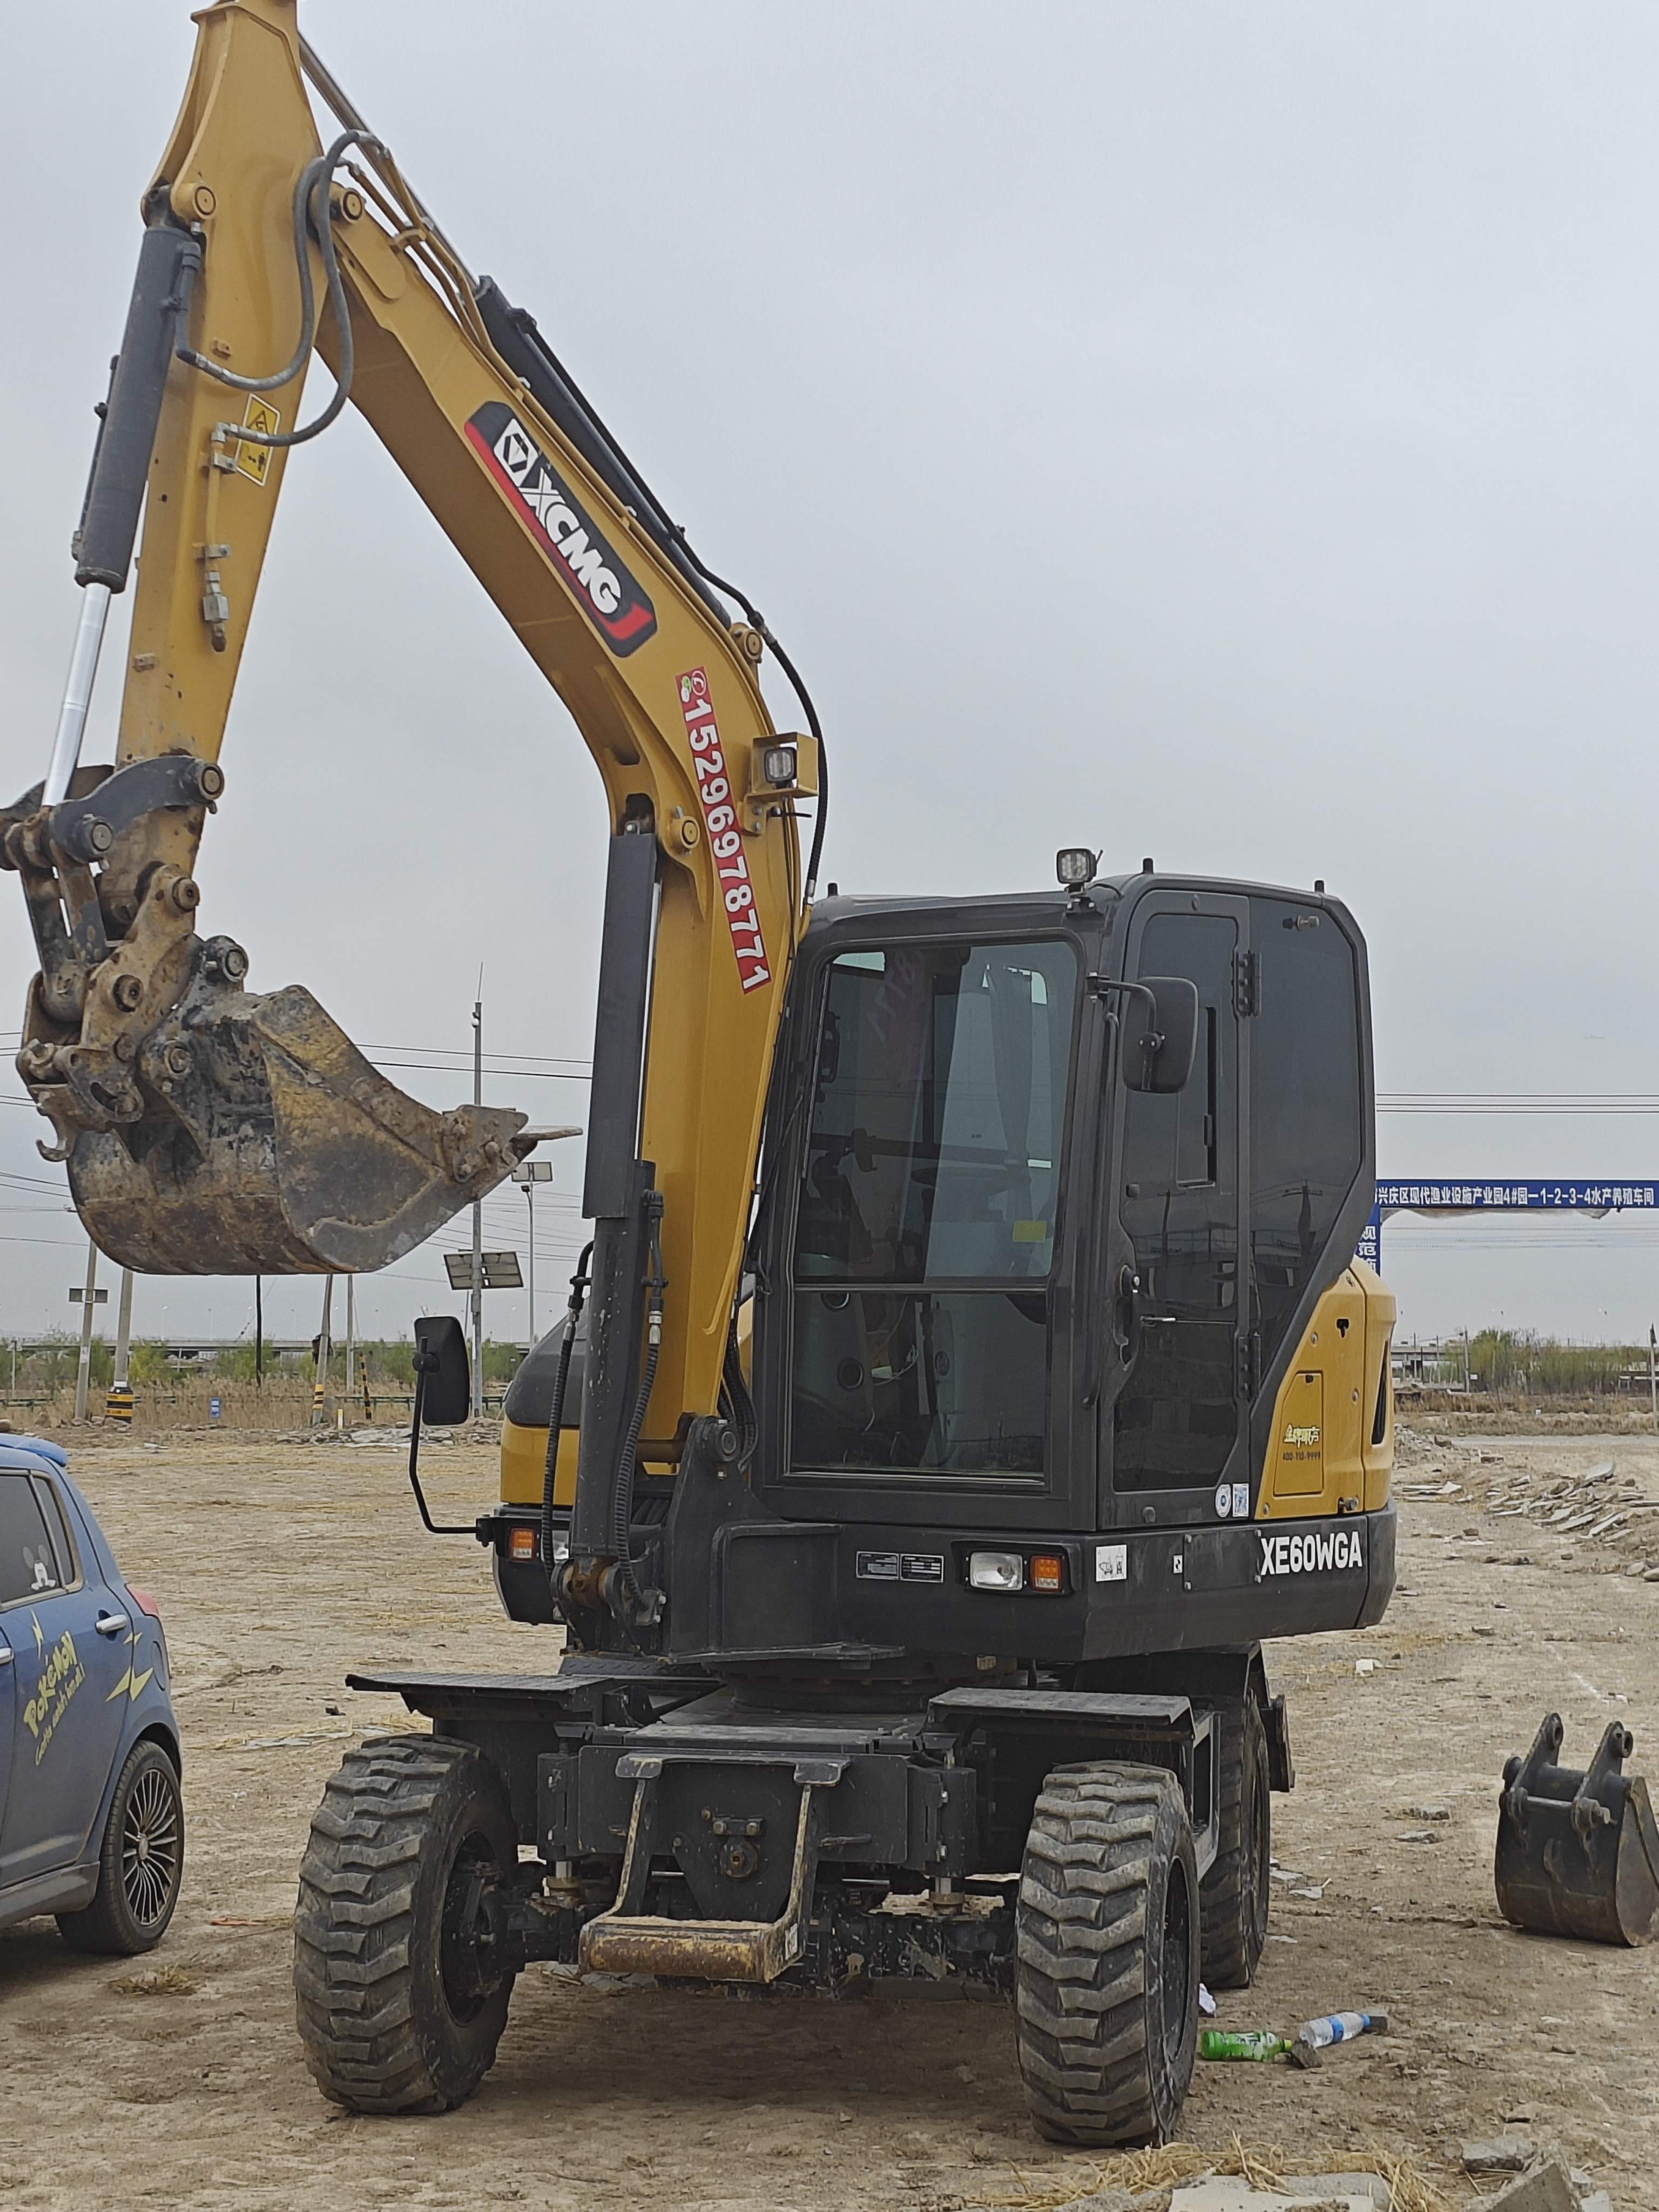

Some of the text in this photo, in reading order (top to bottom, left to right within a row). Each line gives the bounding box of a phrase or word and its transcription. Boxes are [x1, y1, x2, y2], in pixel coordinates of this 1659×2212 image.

[517, 467, 622, 614] XCMG
[684, 698, 770, 990] 15296978771
[1260, 1531, 1363, 1576] XE60WGA
